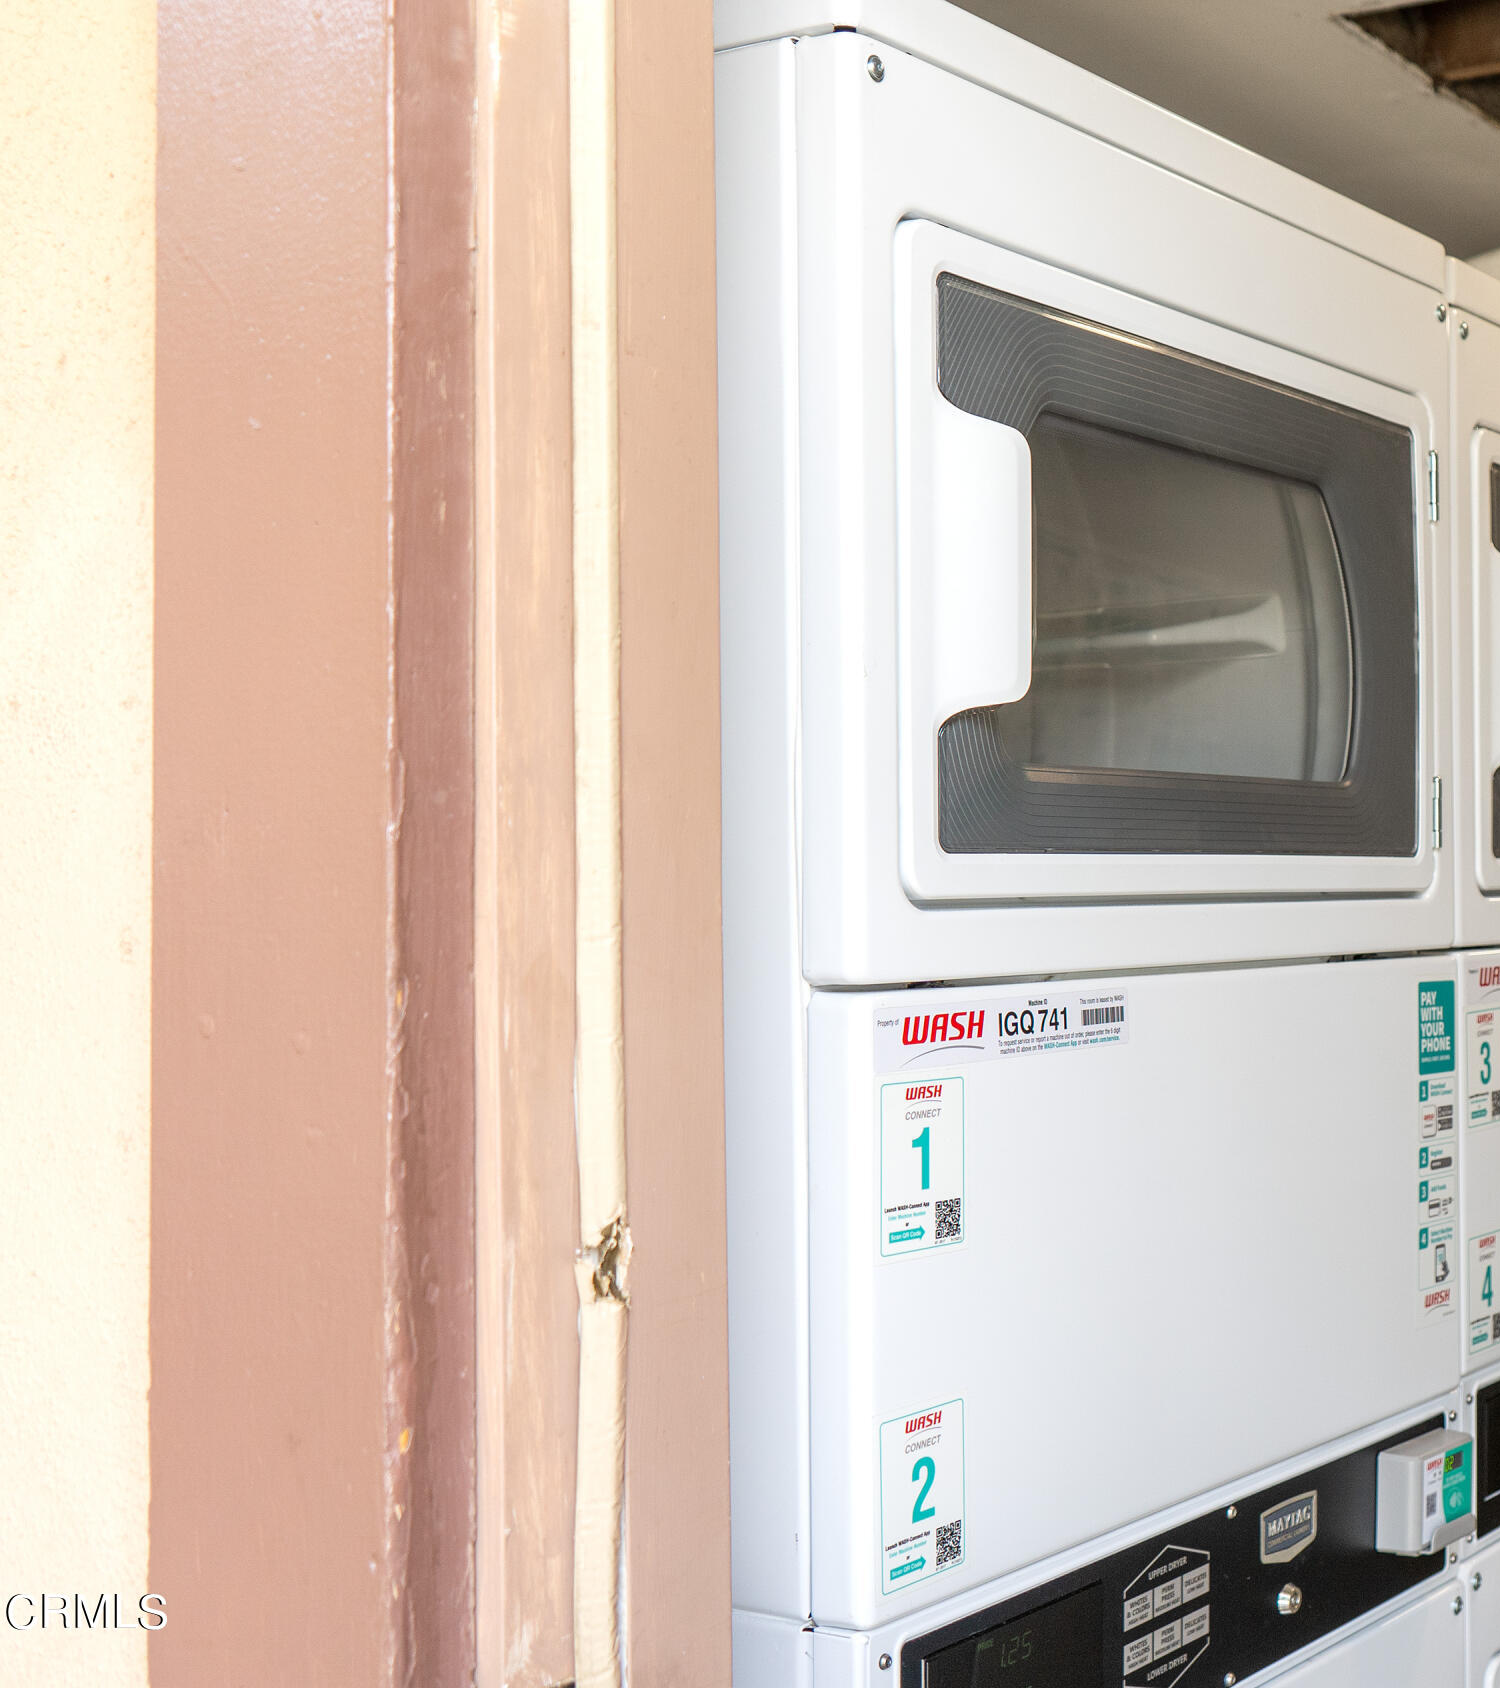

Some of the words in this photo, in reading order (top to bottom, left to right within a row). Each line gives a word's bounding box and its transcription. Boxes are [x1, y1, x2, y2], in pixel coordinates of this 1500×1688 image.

[1421, 991, 1437, 1006] PAY
[1421, 1006, 1443, 1021] WITH
[902, 1010, 985, 1045] WASH
[998, 1009, 1034, 1037] IGQ
[1038, 1007, 1068, 1032] 741
[1421, 1022, 1444, 1037] YOUR
[1421, 1036, 1450, 1053] PHONE
[1480, 1041, 1491, 1085] 3
[905, 1084, 942, 1100] WASH
[905, 1108, 941, 1120] CONNECT
[912, 1127, 930, 1190] 1
[1422, 1152, 1427, 1166] 2
[1422, 1185, 1427, 1199] 3
[911, 1230, 921, 1238] Code
[1482, 1265, 1493, 1307] 4
[1424, 1288, 1450, 1308] WASH
[905, 1410, 942, 1434] WASH
[905, 1434, 941, 1454] CONNECT
[912, 1456, 935, 1524] 2
[1268, 1505, 1310, 1537] MAYTAG
[911, 1561, 922, 1570] Code
[1148, 1564, 1167, 1580] UPPER
[1168, 1556, 1188, 1571] DRYER
[1184, 1572, 1207, 1588] DELICATES
[1161, 1584, 1175, 1593] PERM
[1130, 1595, 1148, 1609] WHITES
[1161, 1591, 1175, 1602] PRESS
[1132, 1603, 1151, 1616] COLORS
[1184, 1614, 1207, 1629] DELICATES
[1161, 1626, 1175, 1636] PERM
[1130, 1640, 1148, 1653] WHITES
[1161, 1634, 1175, 1645] PRESS
[1132, 1647, 1150, 1659] COLORS
[1147, 1664, 1168, 1681] LOWER
[1169, 1653, 1188, 1670] DRYER
